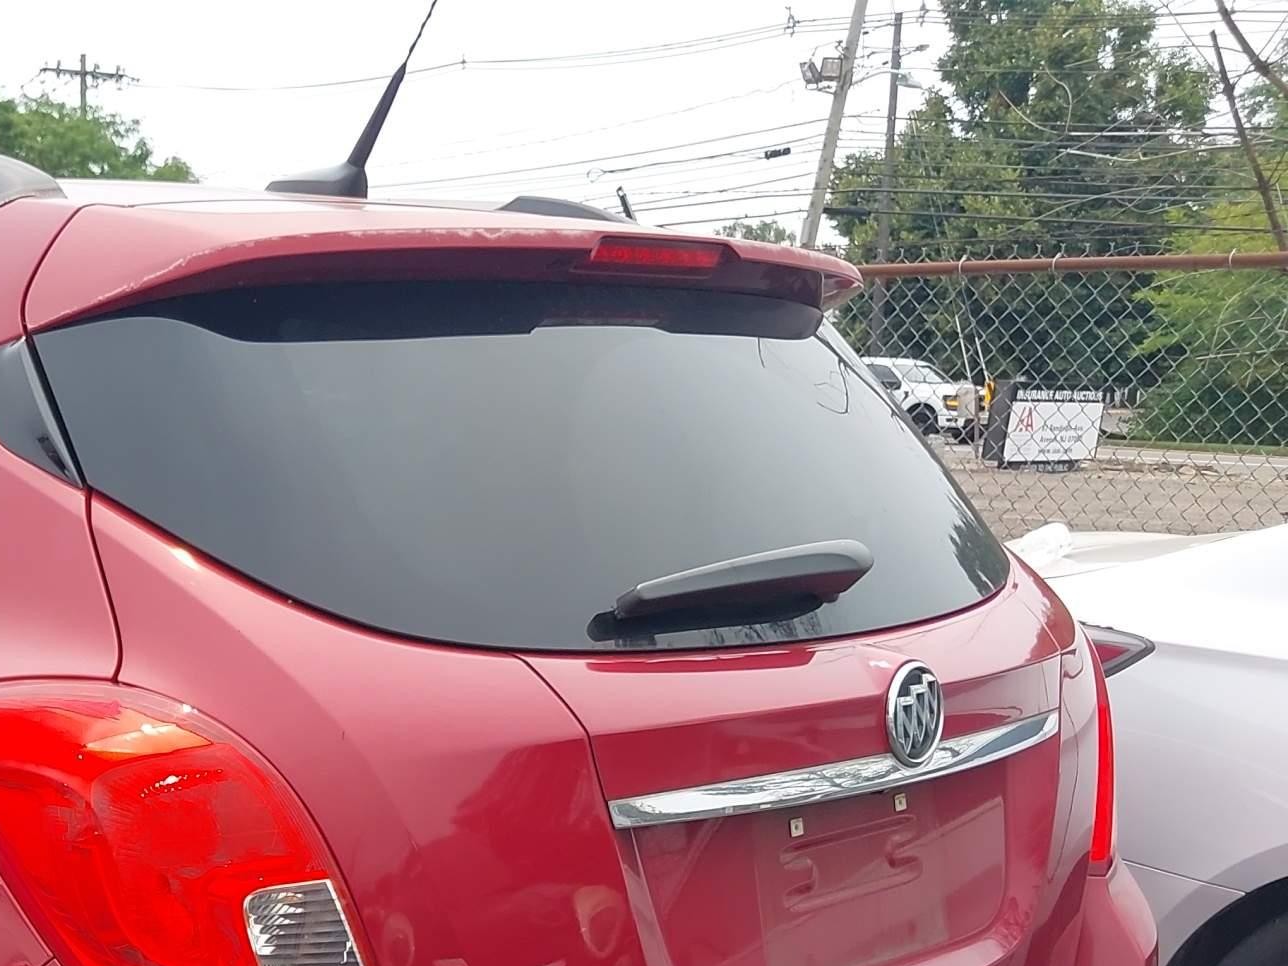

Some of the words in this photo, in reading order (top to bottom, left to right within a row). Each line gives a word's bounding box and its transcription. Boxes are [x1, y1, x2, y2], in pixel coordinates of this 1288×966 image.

[1016, 390, 1053, 400] INSURANCE
[1054, 391, 1071, 400] AUTO
[1072, 391, 1103, 400] AUCTIONS
